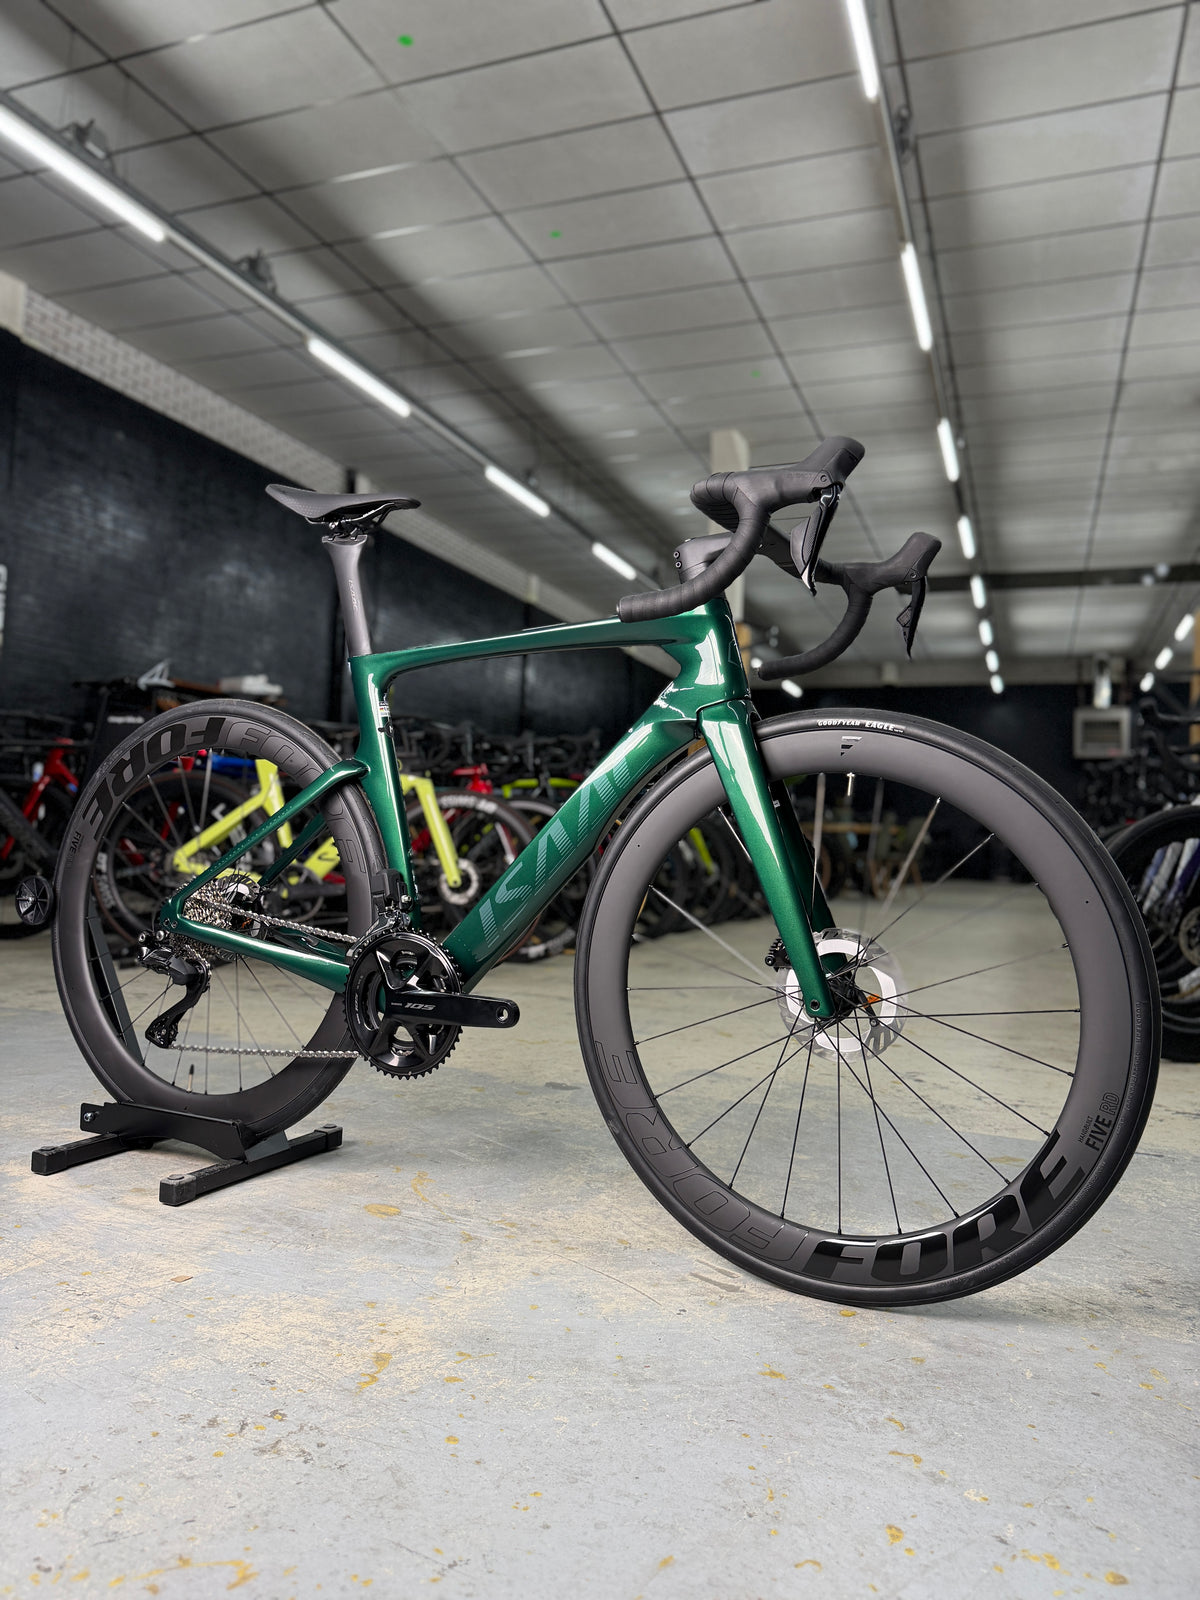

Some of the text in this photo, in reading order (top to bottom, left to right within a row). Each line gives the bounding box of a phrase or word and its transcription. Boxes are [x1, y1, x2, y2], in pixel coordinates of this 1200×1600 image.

[817, 719, 860, 727] GOODYEAR
[864, 720, 895, 732] EAGLE
[82, 717, 226, 842] FORE
[69, 831, 82, 854] FIVE
[404, 1002, 436, 1011] 105
[1084, 1091, 1121, 1152] FIVE RD
[801, 1129, 1086, 1284] FORE
